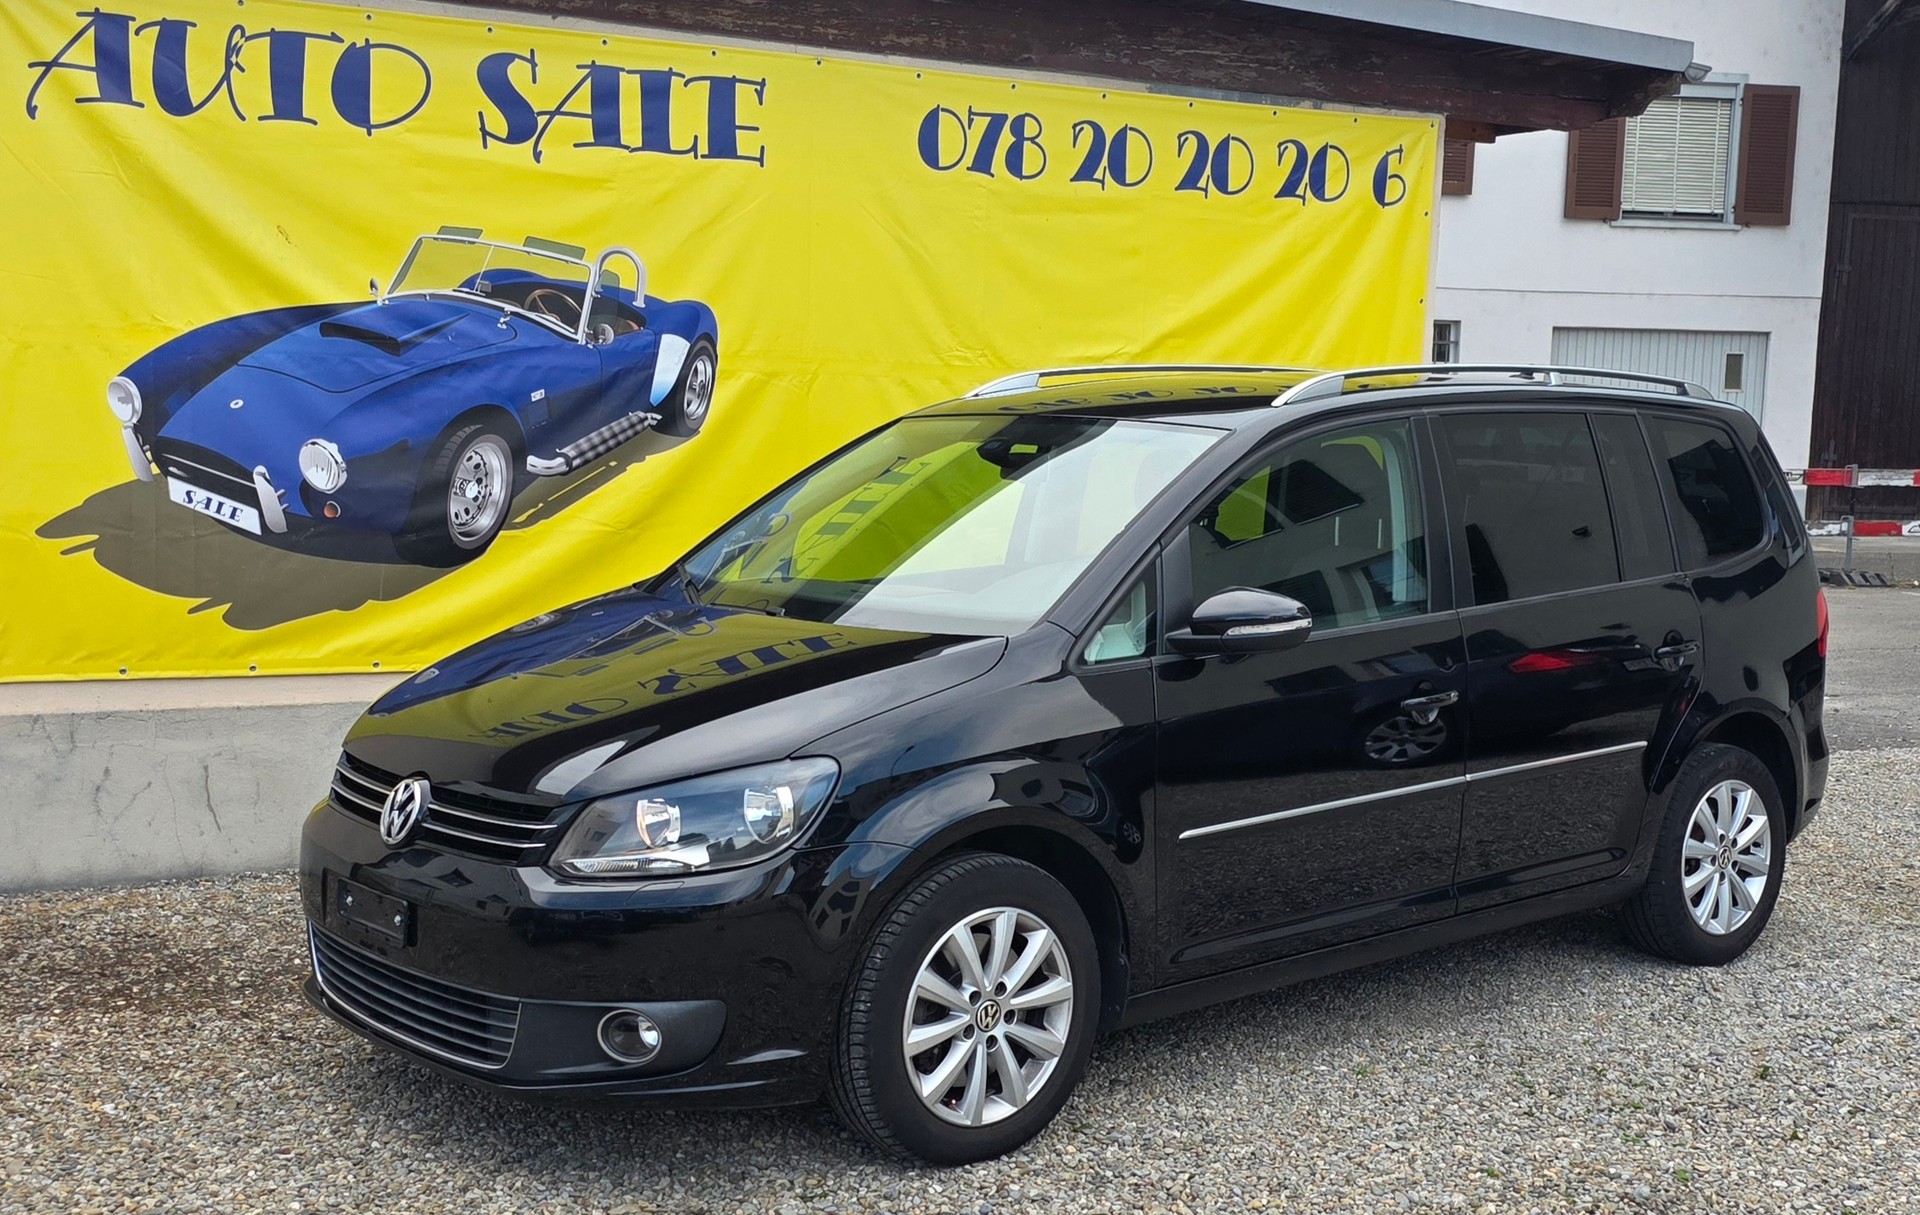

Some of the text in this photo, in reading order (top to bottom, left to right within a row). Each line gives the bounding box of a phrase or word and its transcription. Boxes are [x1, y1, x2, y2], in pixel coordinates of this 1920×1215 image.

[26, 7, 767, 167] AUTO SALE
[917, 104, 1407, 209] 078 20 20 20 6
[182, 489, 244, 523] SALE
